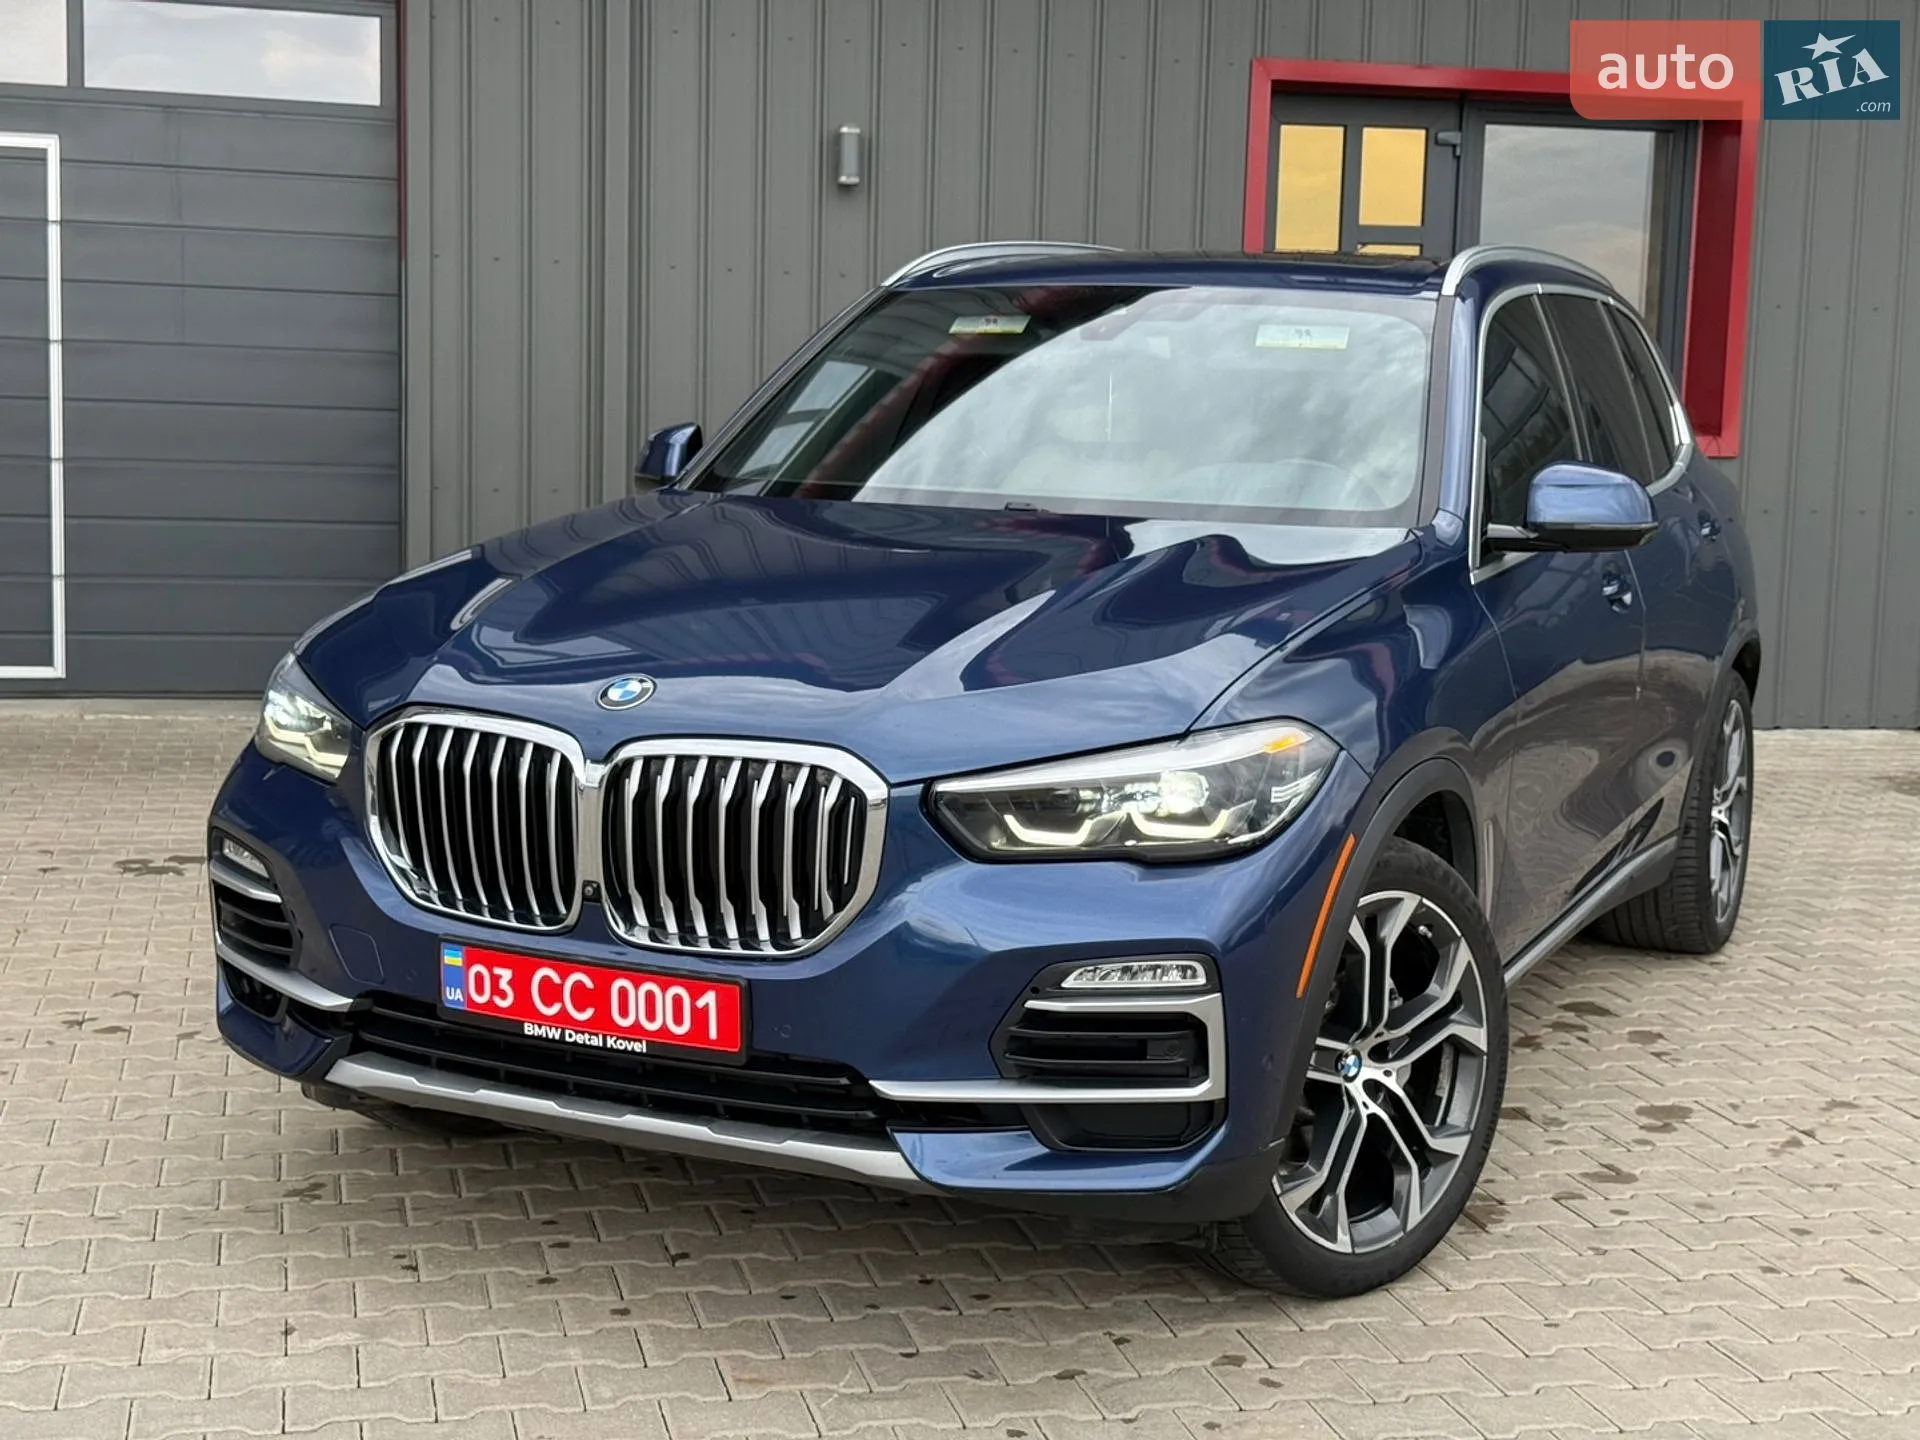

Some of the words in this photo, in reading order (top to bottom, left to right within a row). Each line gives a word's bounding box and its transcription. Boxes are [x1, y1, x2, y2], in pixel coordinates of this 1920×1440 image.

[446, 986, 464, 1002] UA
[468, 964, 514, 1008] 03
[530, 967, 595, 1022] CC
[610, 978, 717, 1040] 0001
[524, 1022, 562, 1040] BMW
[565, 1028, 603, 1047] Detal
[606, 1034, 647, 1053] Kovel
